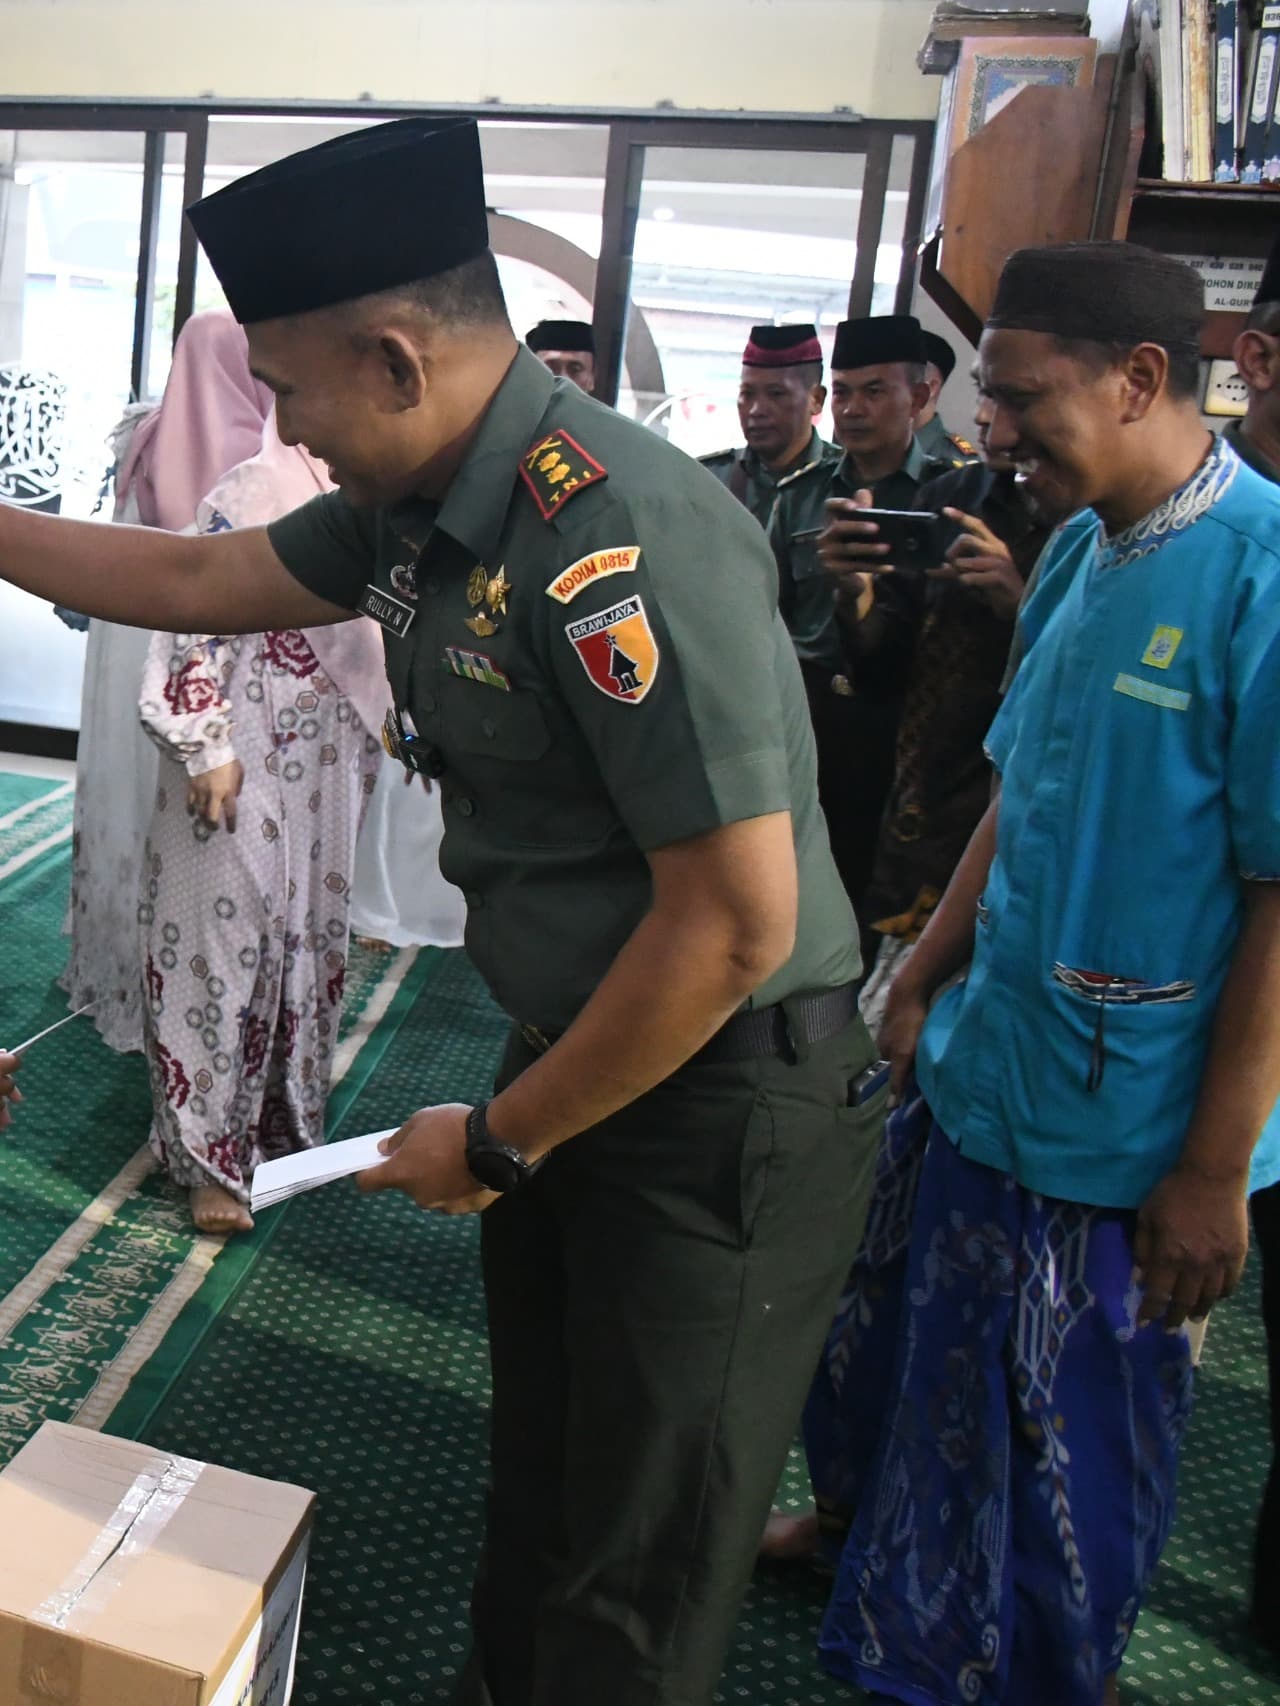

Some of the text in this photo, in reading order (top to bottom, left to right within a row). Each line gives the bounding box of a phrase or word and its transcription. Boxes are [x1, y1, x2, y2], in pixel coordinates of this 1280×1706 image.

[555, 553, 629, 597] KODIM 0815
[572, 603, 635, 637] BRAWIJAYA
